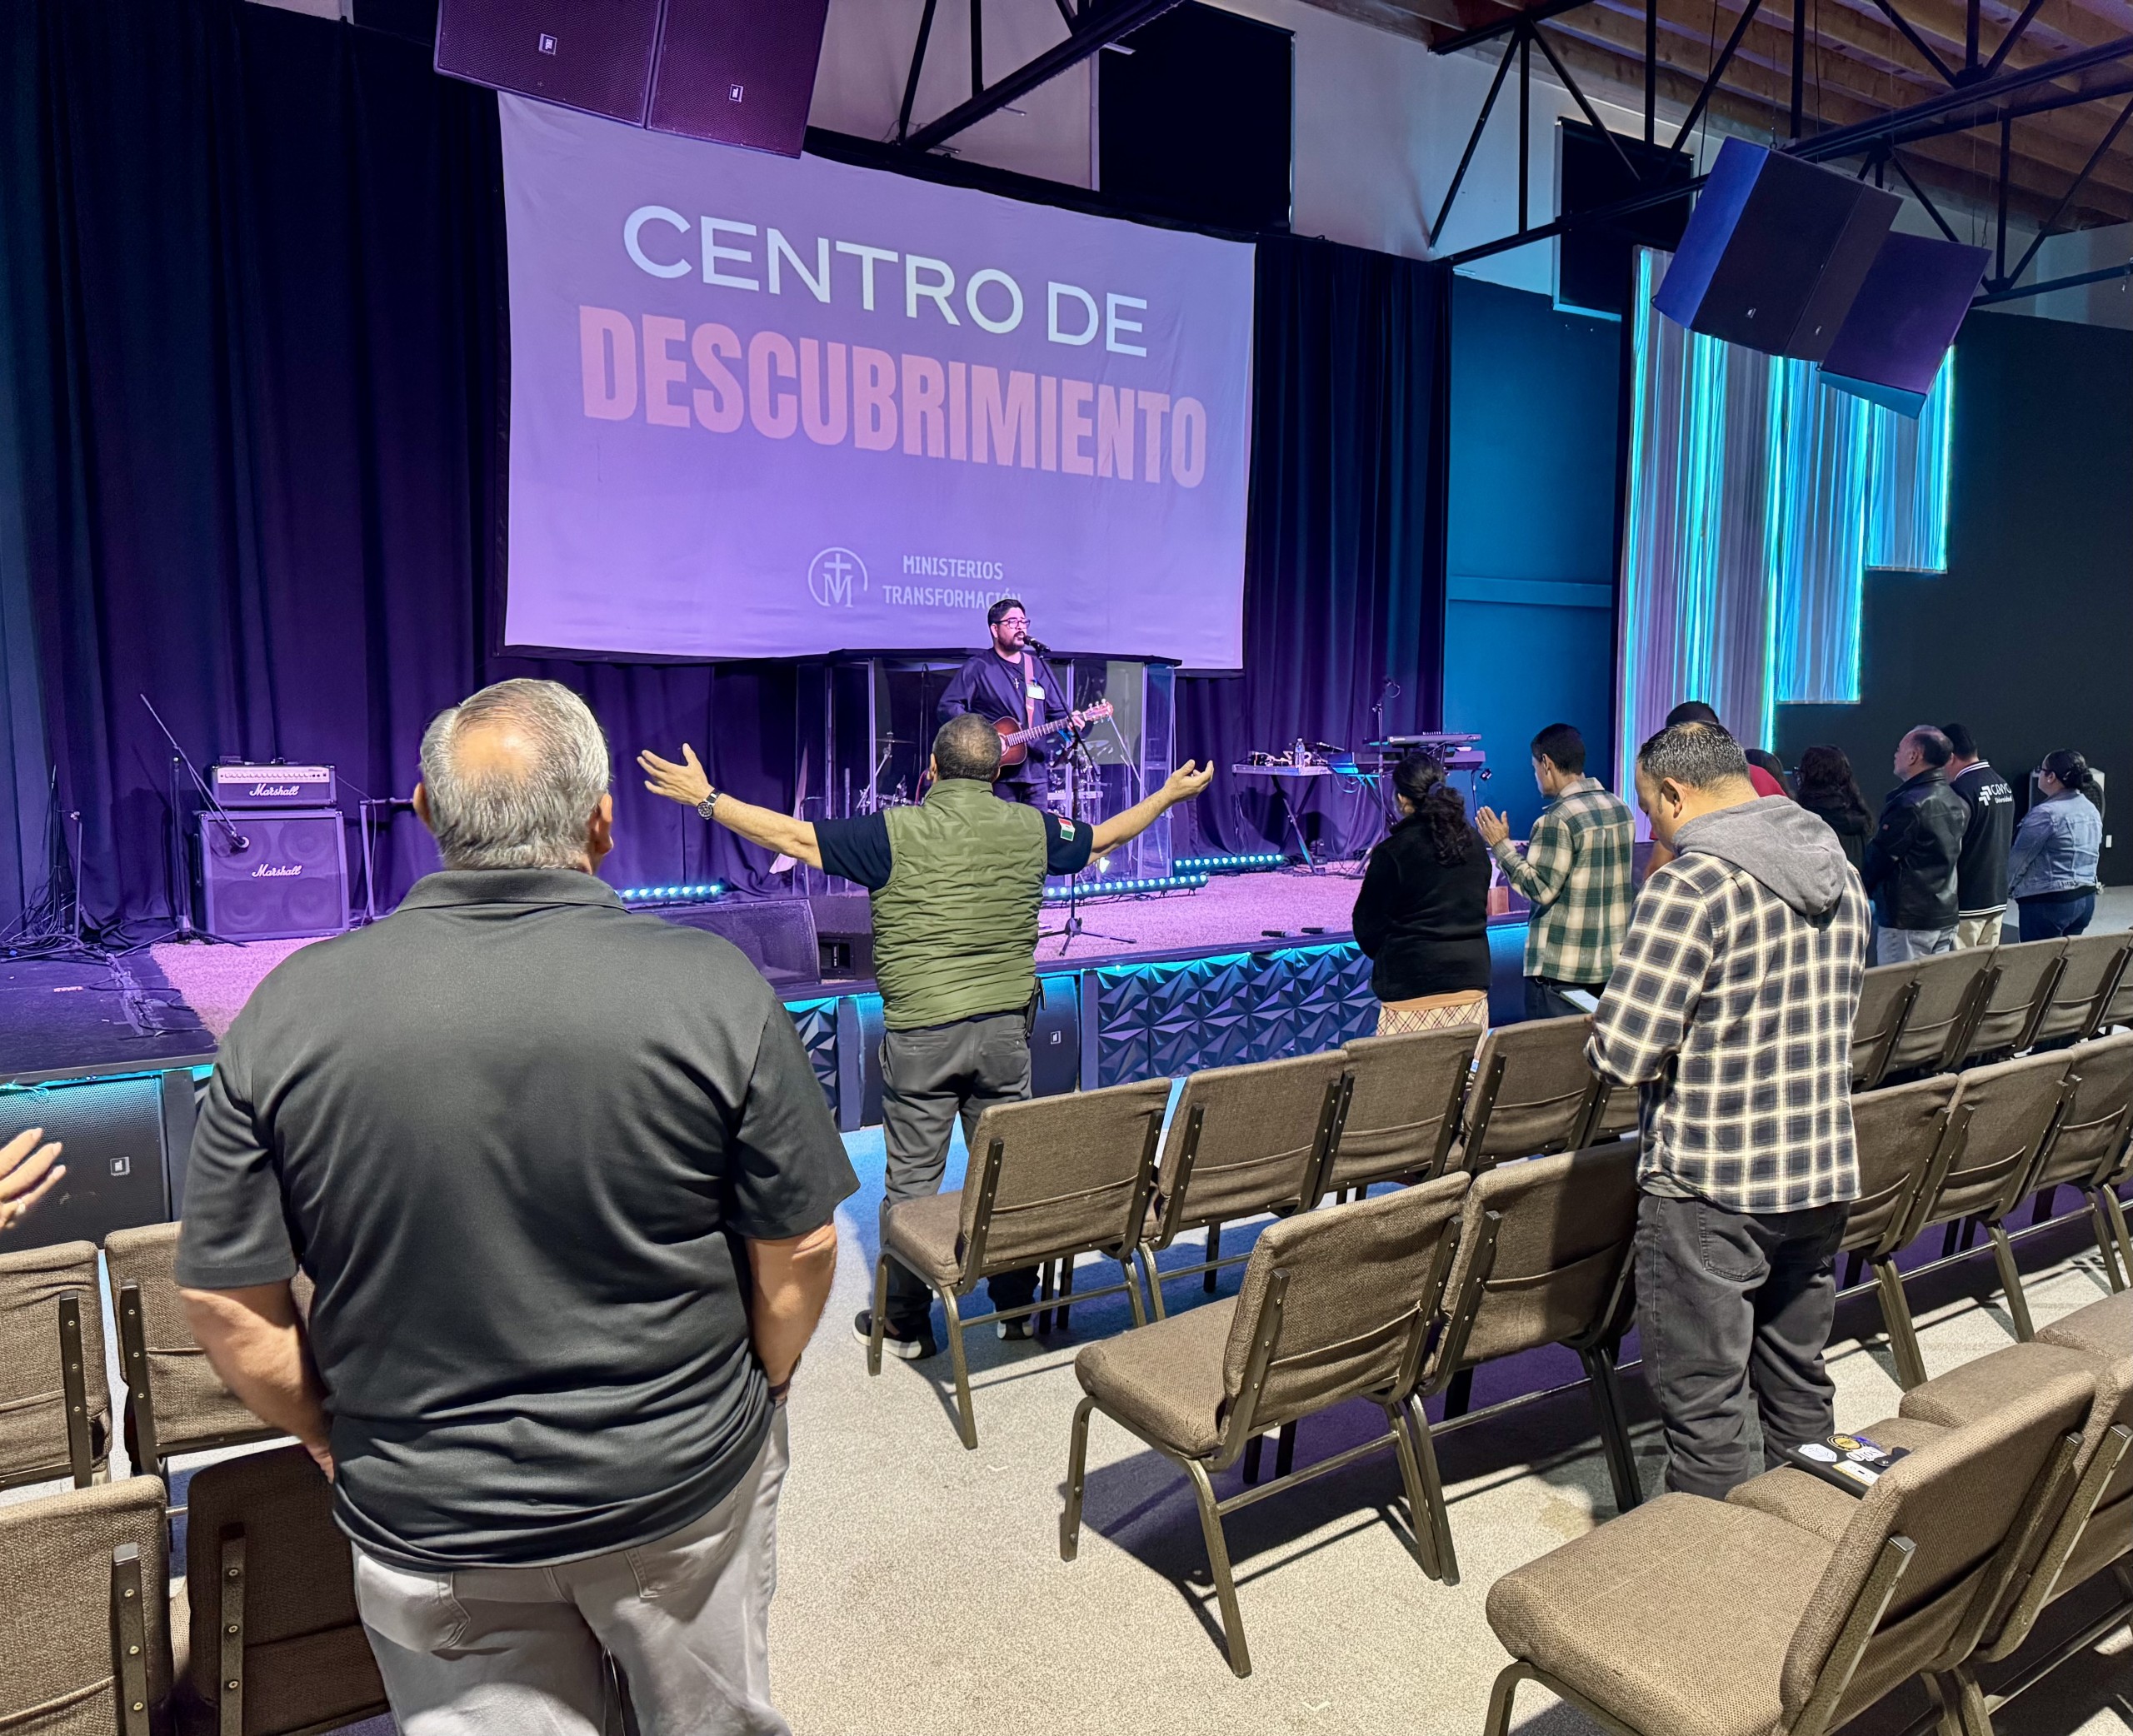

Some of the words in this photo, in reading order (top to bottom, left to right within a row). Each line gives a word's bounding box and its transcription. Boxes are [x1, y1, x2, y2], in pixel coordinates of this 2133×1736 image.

[623, 205, 1024, 335] CENTRO
[1047, 281, 1149, 358] DE
[579, 305, 1208, 490] DESCUBRIMIENTO
[902, 555, 1004, 581] MINISTERIOS
[249, 783, 300, 796] Marshall
[252, 863, 302, 877] Marshall
